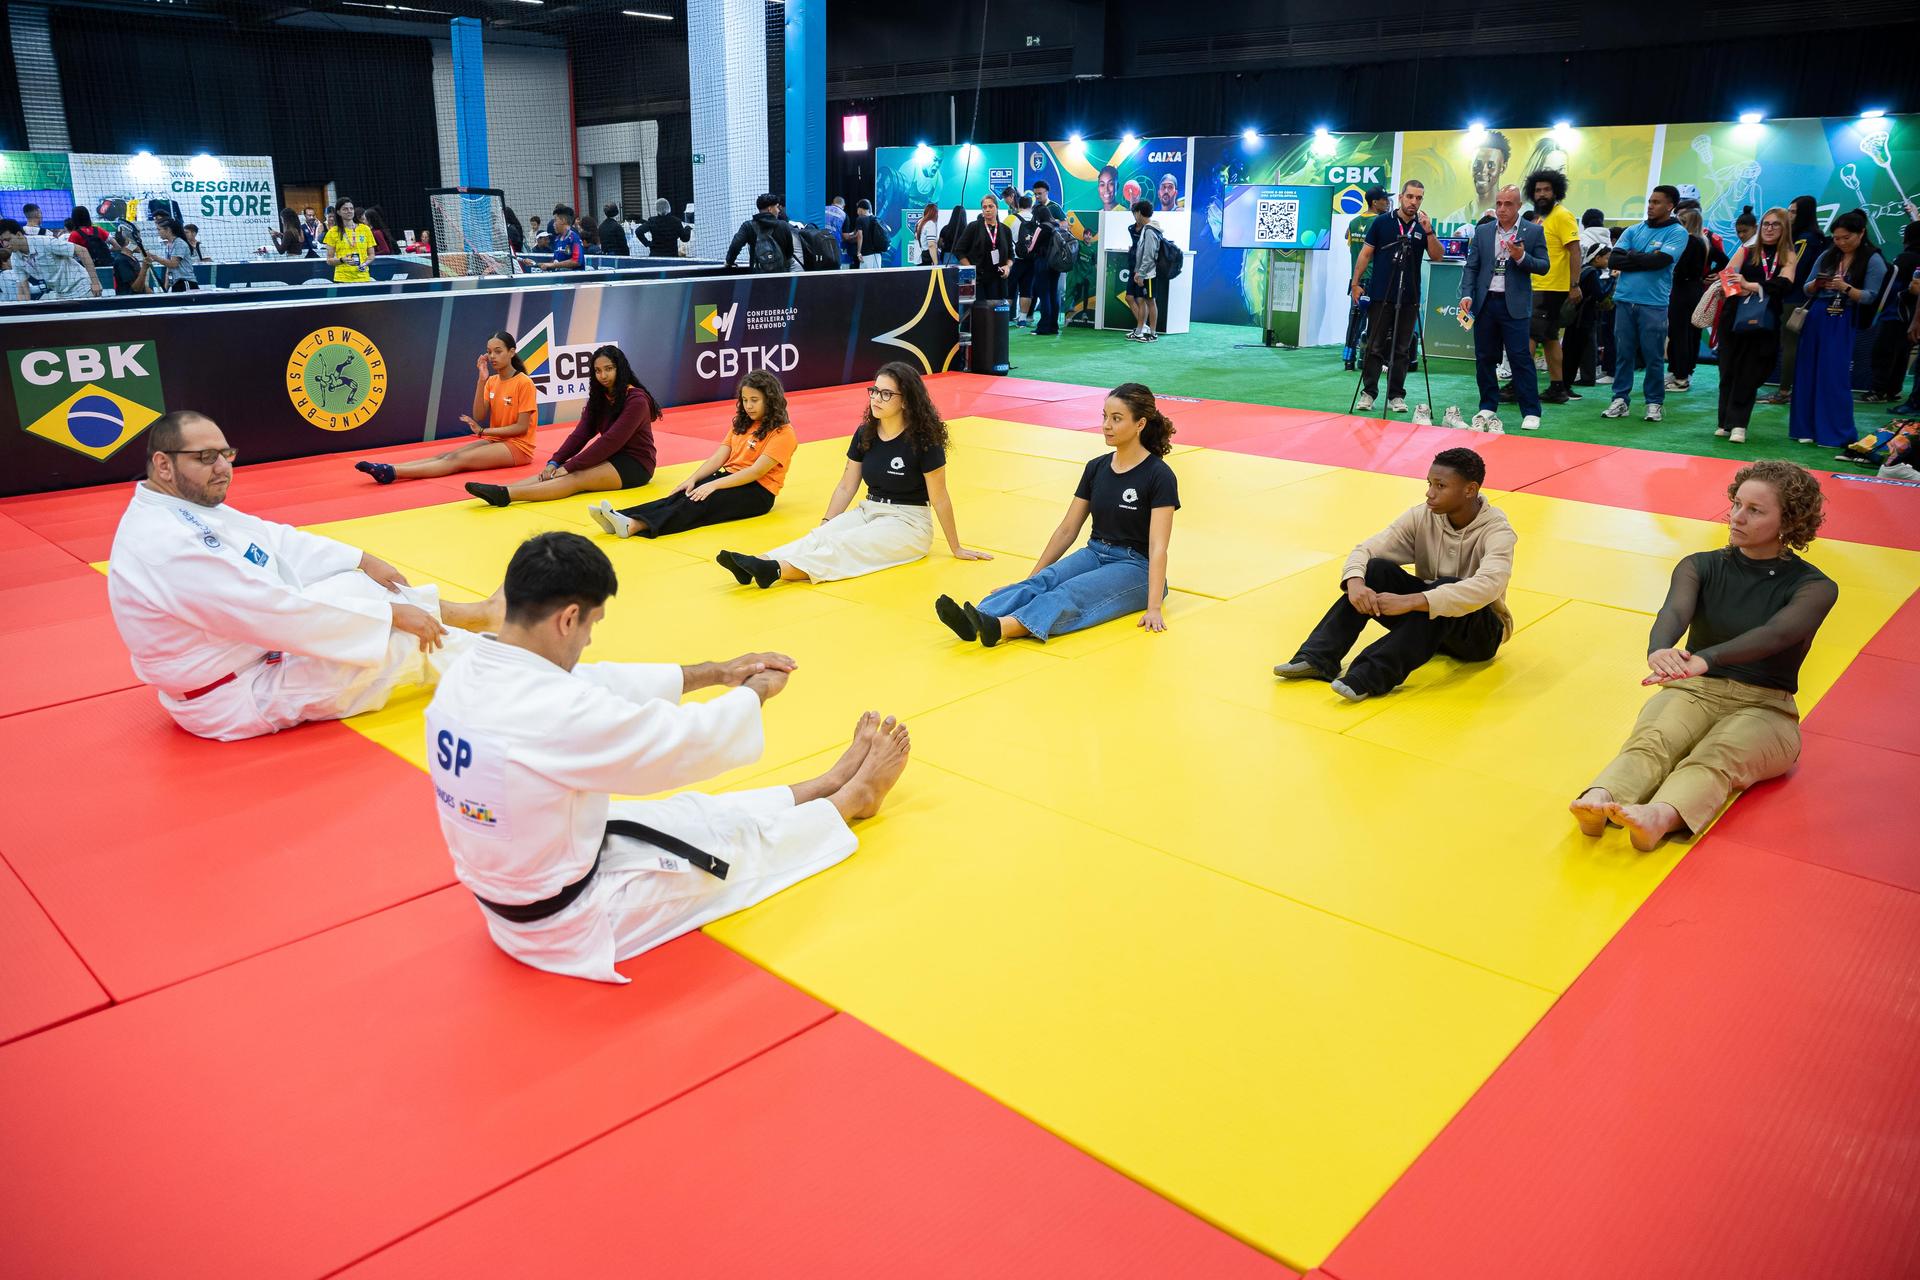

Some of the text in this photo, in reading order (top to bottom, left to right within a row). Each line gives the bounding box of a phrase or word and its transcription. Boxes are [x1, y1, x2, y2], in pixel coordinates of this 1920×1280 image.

[1147, 151, 1183, 163] CAIXA
[1328, 166, 1381, 184] CBK
[171, 180, 271, 193] CBESGRIMA
[200, 195, 272, 217] STORE
[746, 307, 798, 317] CONFEDERAÇÃO
[746, 316, 785, 324] BRASILEIRA
[747, 322, 787, 330] TAEKWONDO
[314, 329, 352, 345] CBW
[20, 343, 150, 386] CBK
[696, 343, 800, 380] CBTKD
[289, 350, 317, 419] BRASIL
[330, 344, 385, 428] WRESTLING
[437, 729, 473, 778] SP
